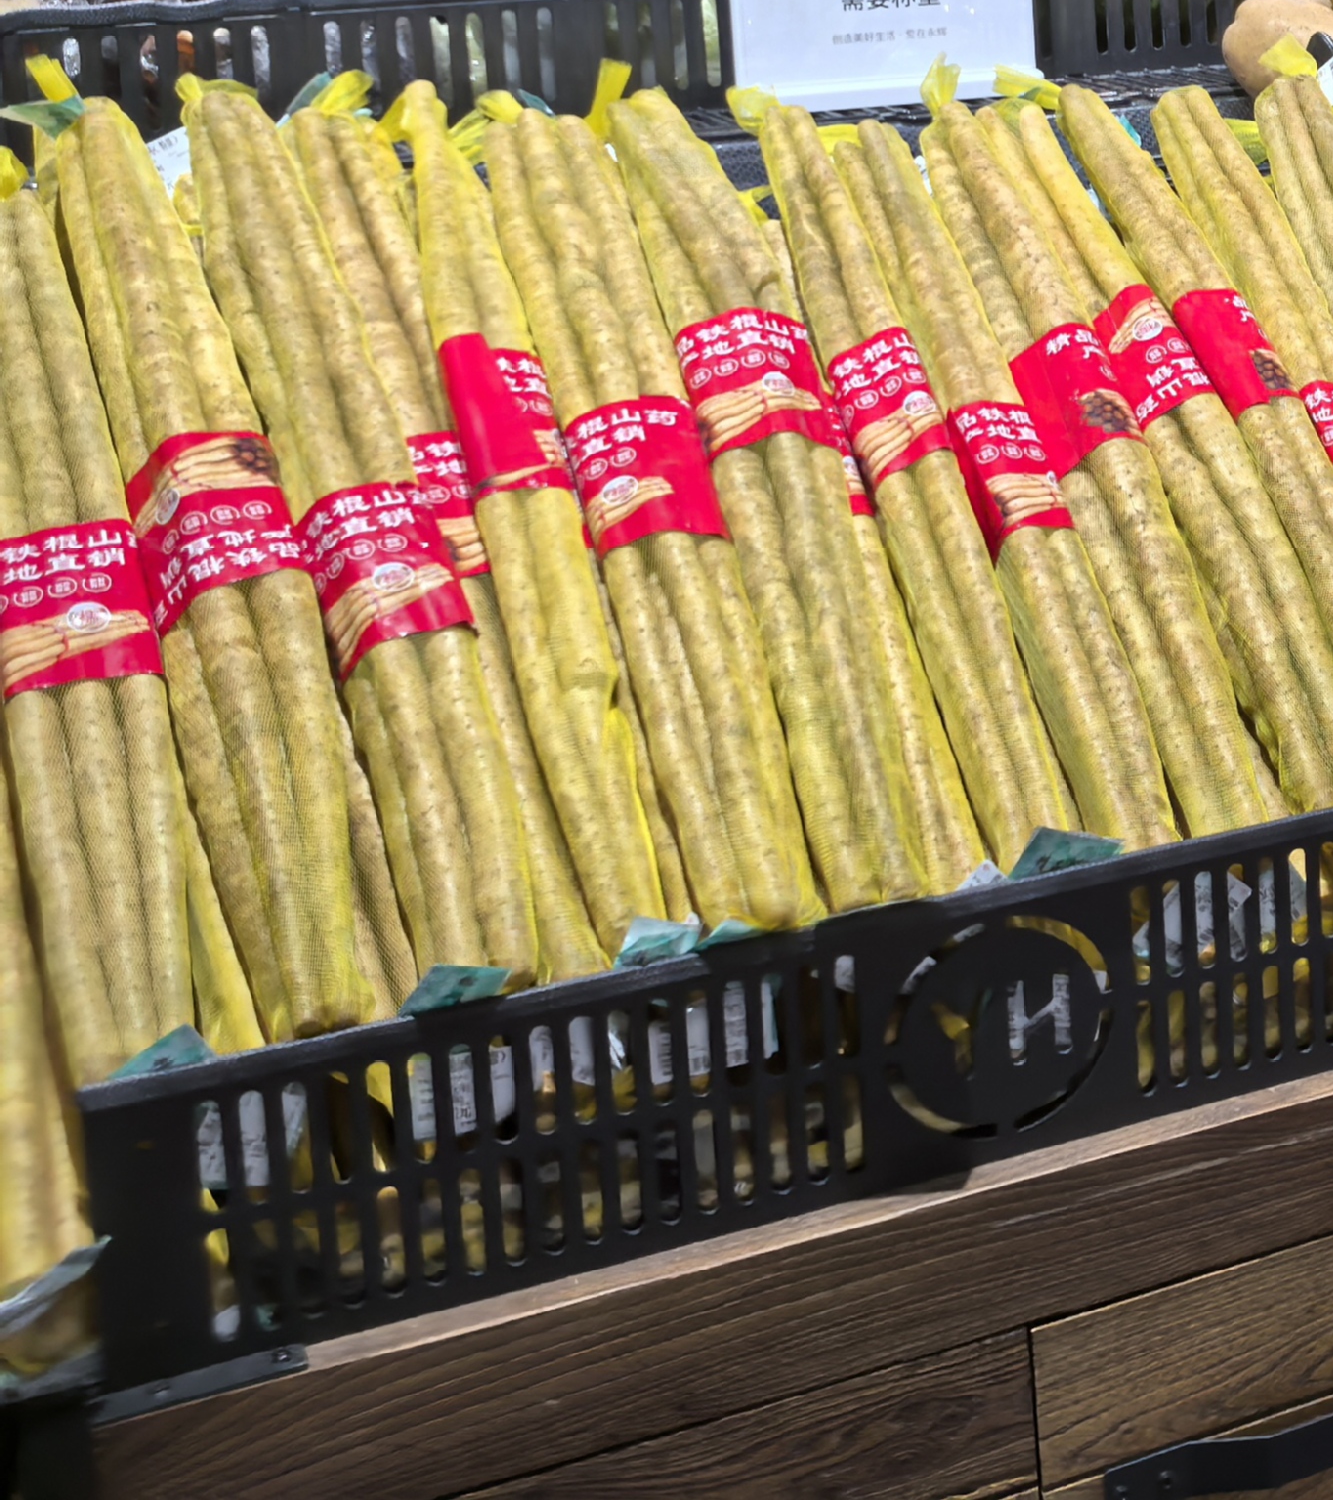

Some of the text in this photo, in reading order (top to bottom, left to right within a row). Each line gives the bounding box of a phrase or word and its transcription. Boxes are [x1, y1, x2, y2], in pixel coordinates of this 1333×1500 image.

[567, 407, 679, 447] 棍山药
[573, 425, 647, 466] 直销
[931, 972, 1072, 1081] YH
